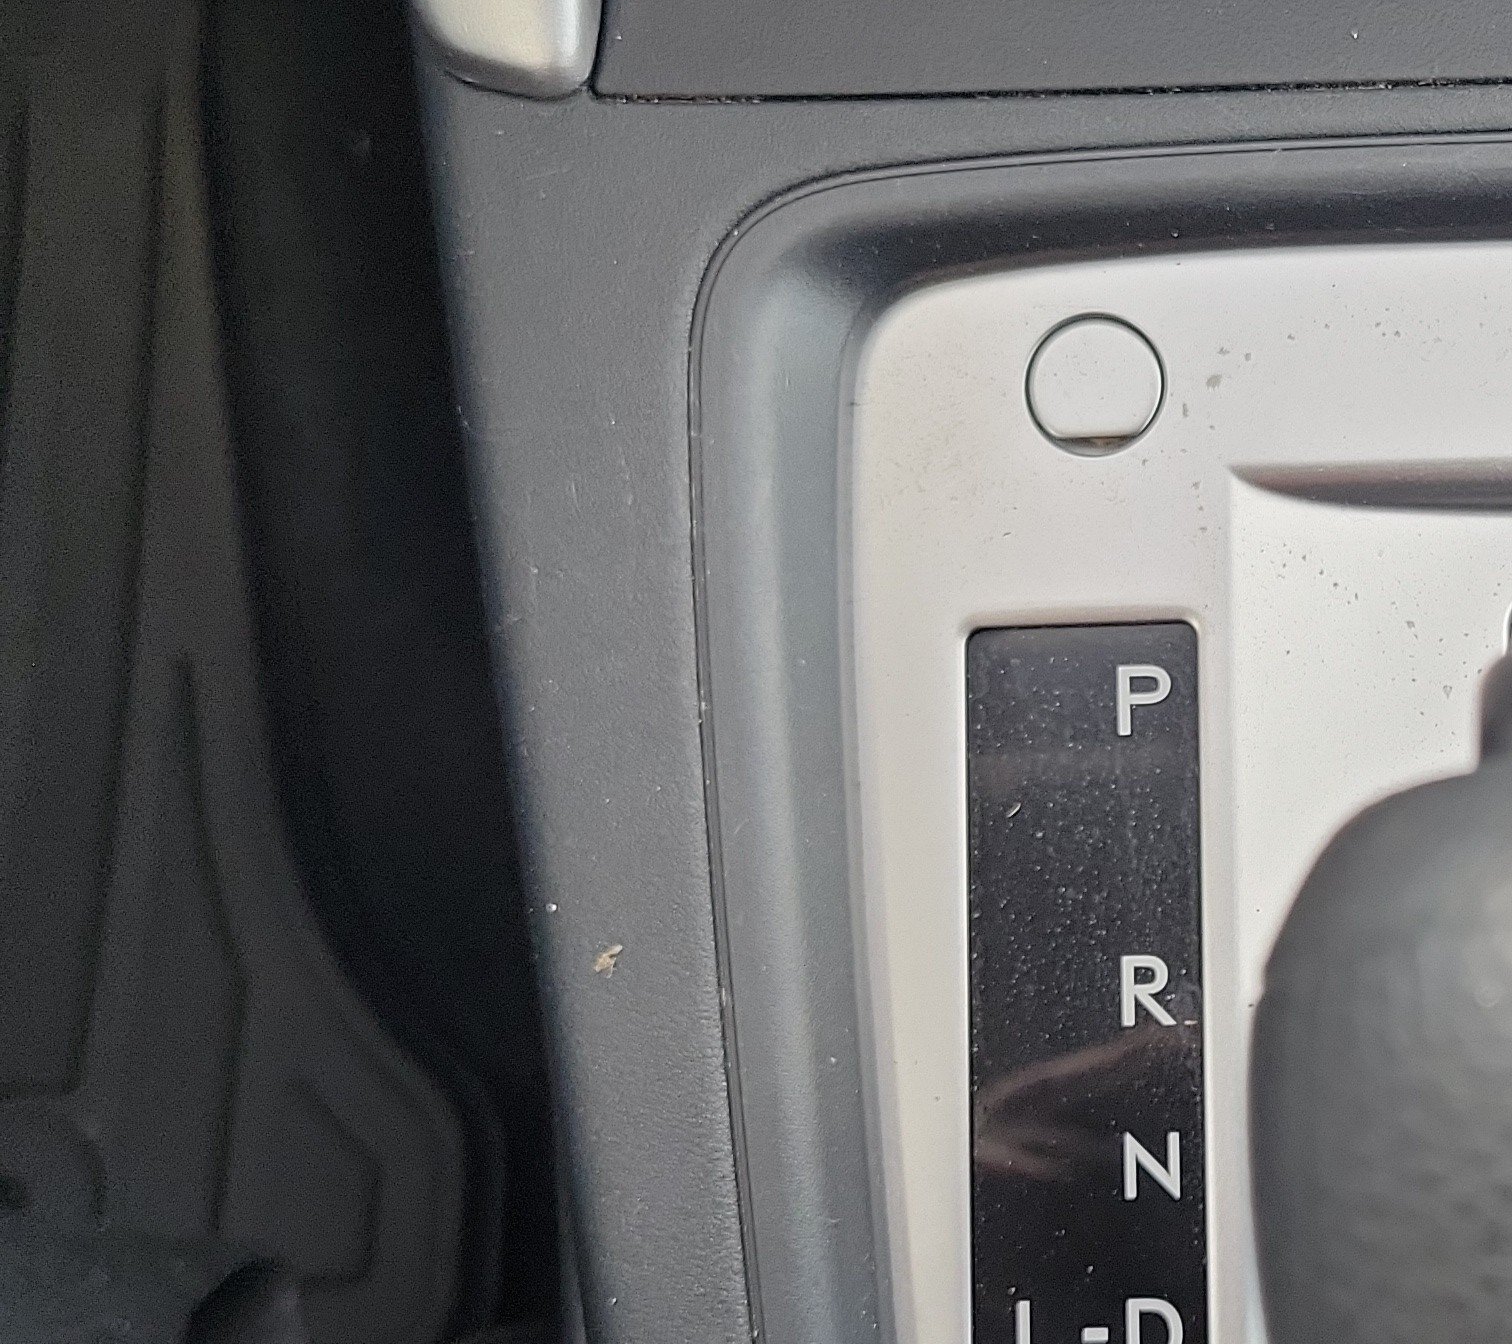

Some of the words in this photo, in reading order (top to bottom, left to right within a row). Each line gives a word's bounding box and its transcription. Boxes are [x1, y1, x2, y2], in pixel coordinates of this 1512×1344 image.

[1115, 664, 1172, 737] P
[1119, 955, 1176, 1028] R
[1122, 1130, 1182, 1201] N
